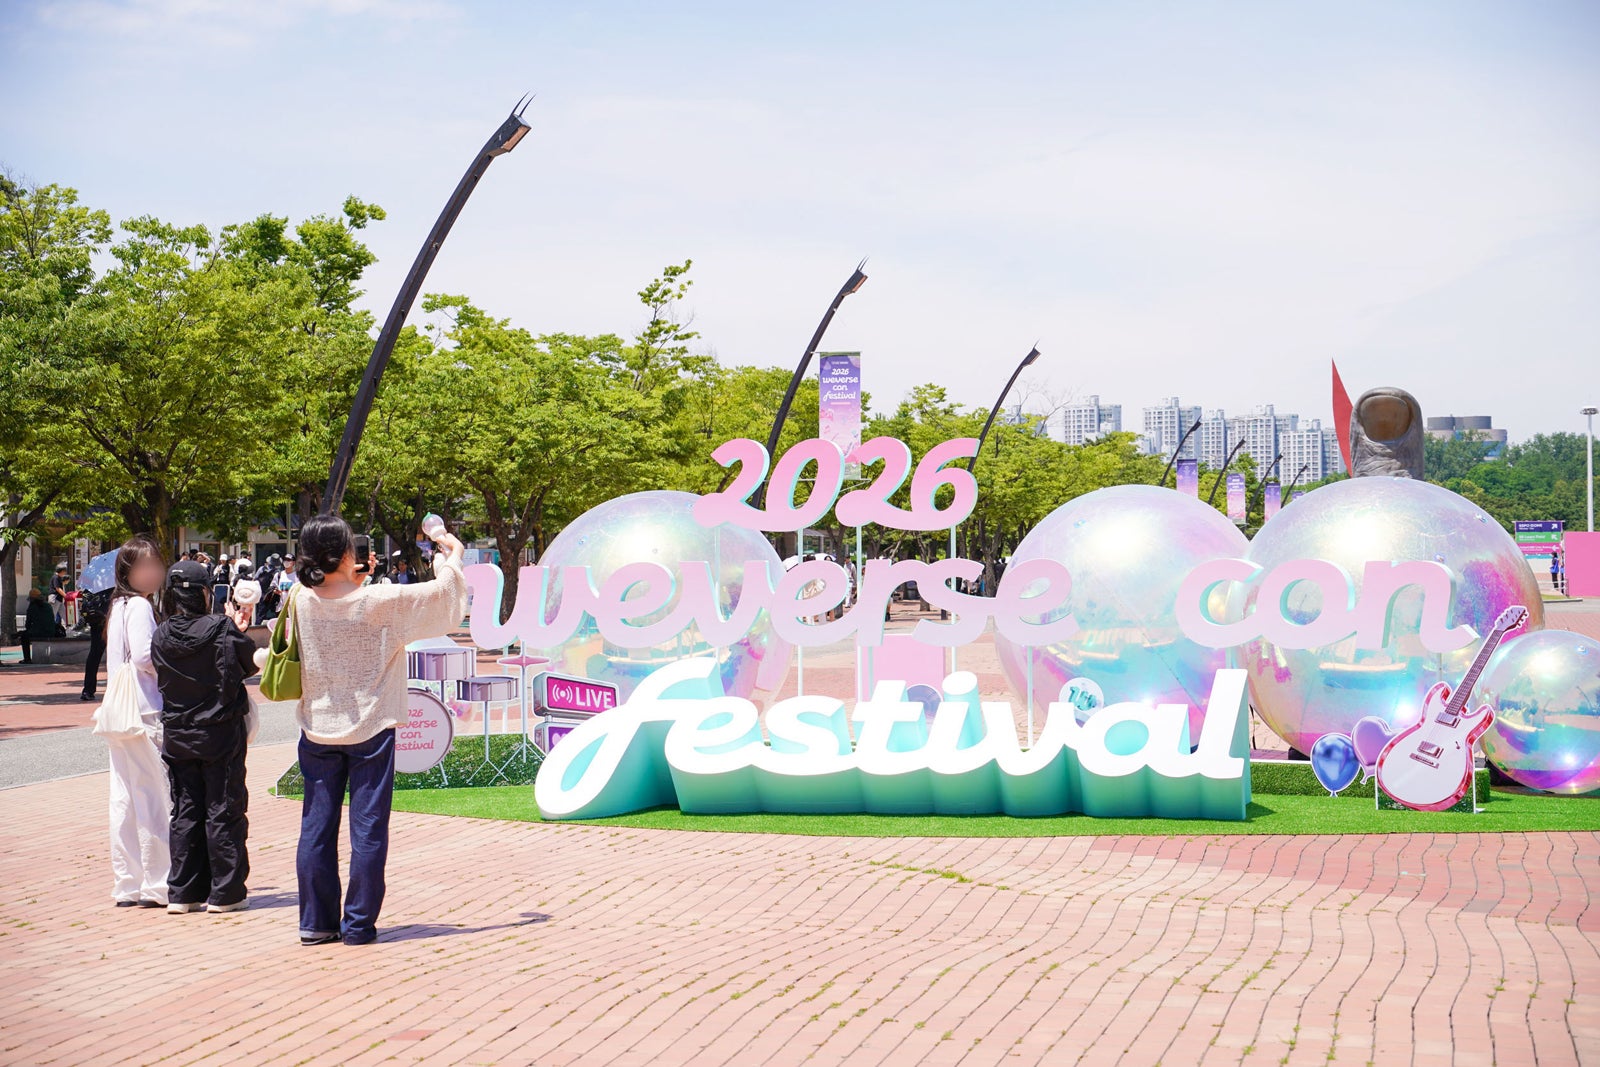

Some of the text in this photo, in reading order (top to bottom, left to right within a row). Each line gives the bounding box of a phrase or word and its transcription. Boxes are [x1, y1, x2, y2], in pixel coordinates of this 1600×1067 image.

[823, 390, 856, 401] festival
[693, 436, 981, 532] 2026
[463, 558, 1480, 653] weverse con
[575, 686, 614, 709] LIVE
[397, 719, 438, 729] verse
[400, 730, 422, 739] con
[535, 655, 1248, 821] festival
[394, 739, 434, 751] estival
